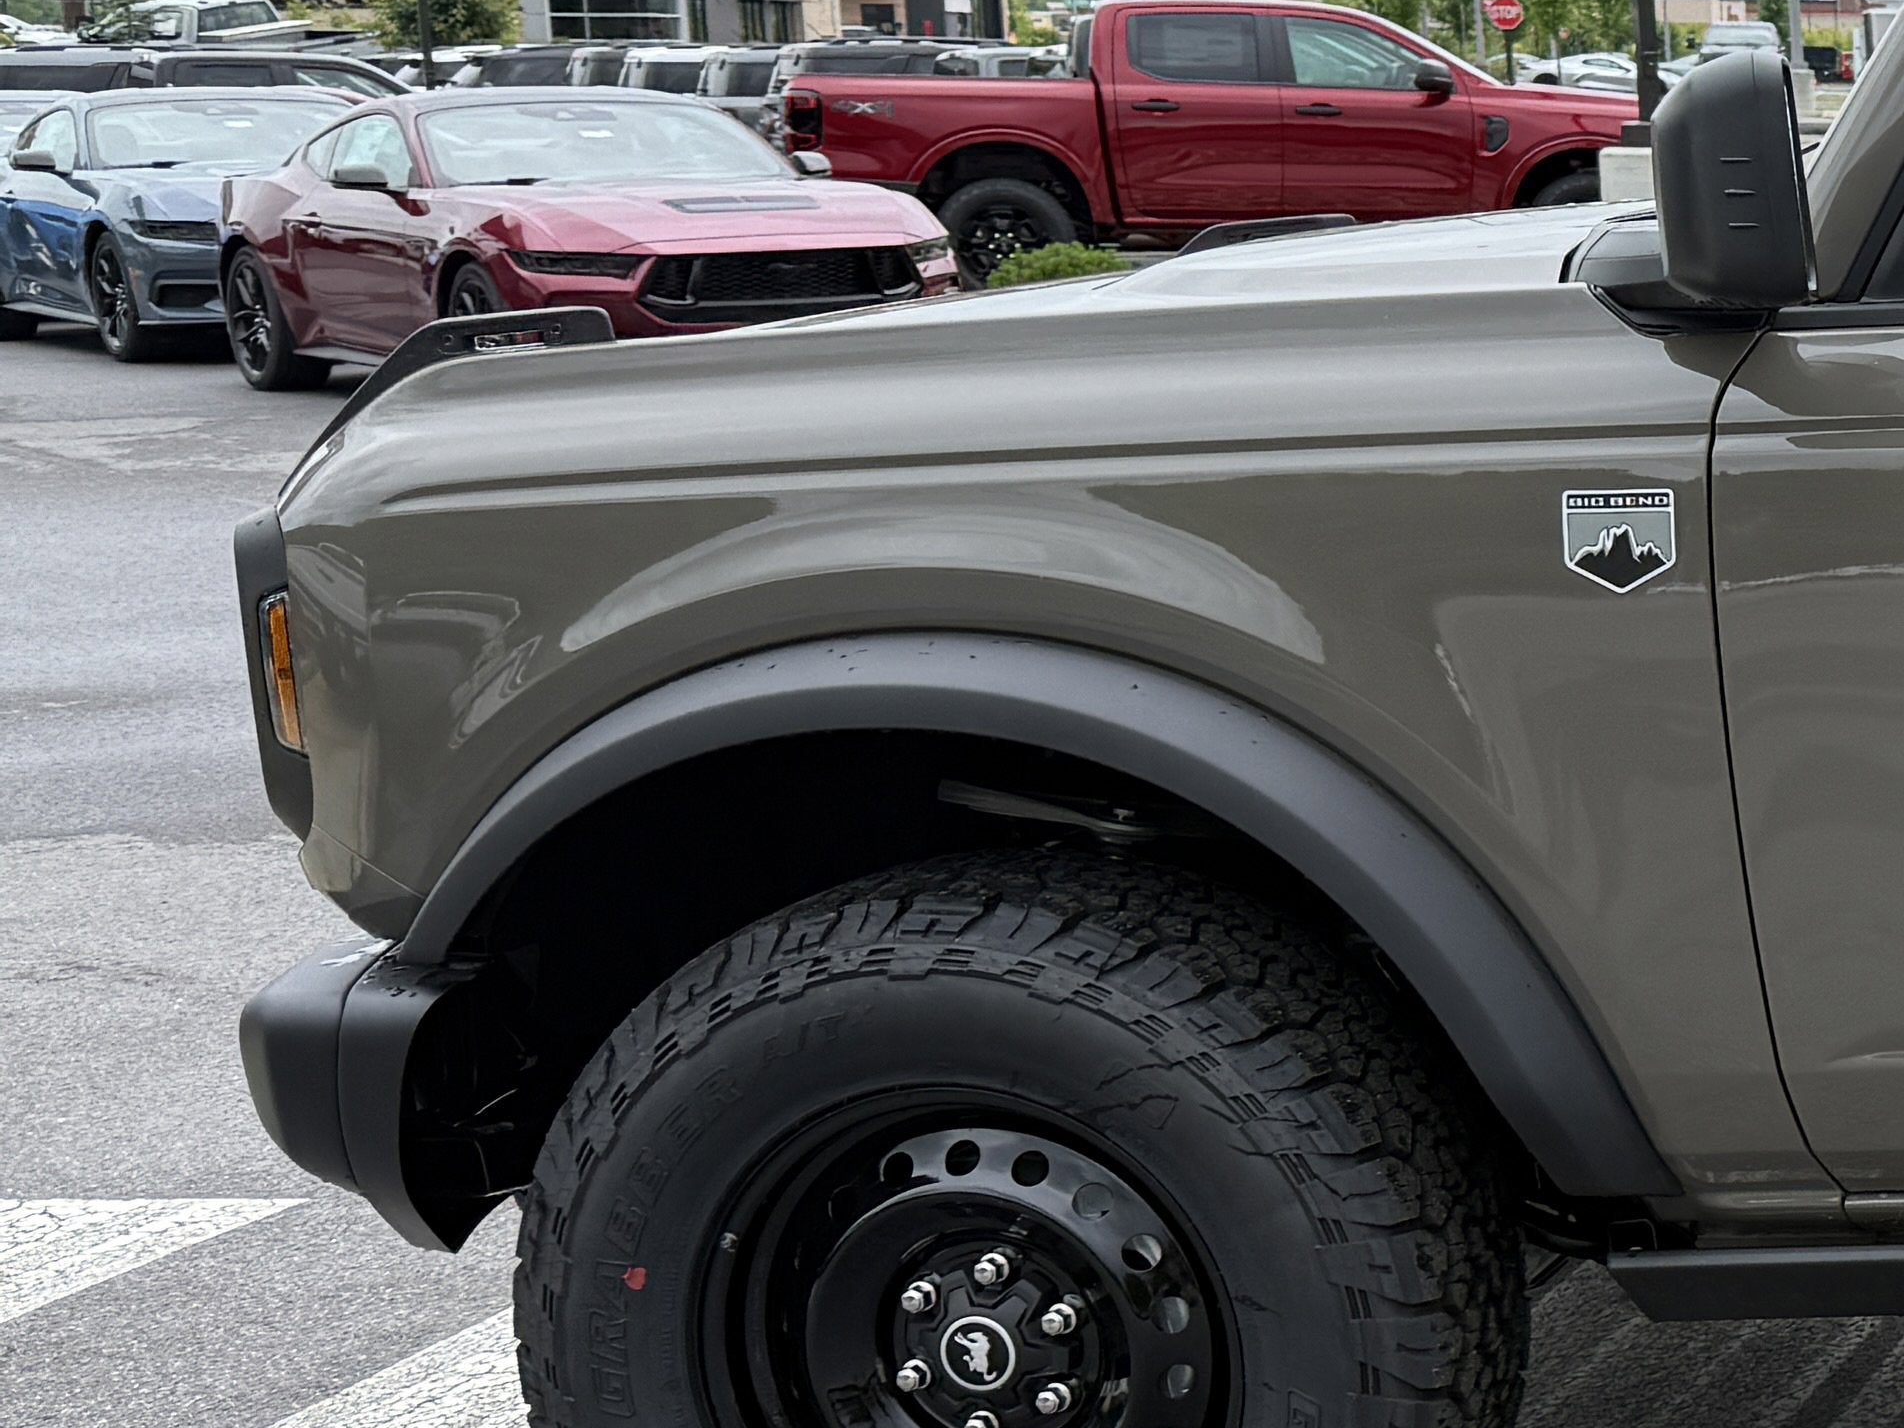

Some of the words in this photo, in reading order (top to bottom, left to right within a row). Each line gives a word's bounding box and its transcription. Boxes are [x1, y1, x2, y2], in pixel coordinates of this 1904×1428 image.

[1568, 497, 1605, 507] BIG
[1610, 496, 1669, 506] BEND
[582, 1064, 748, 1421] GRABBER
